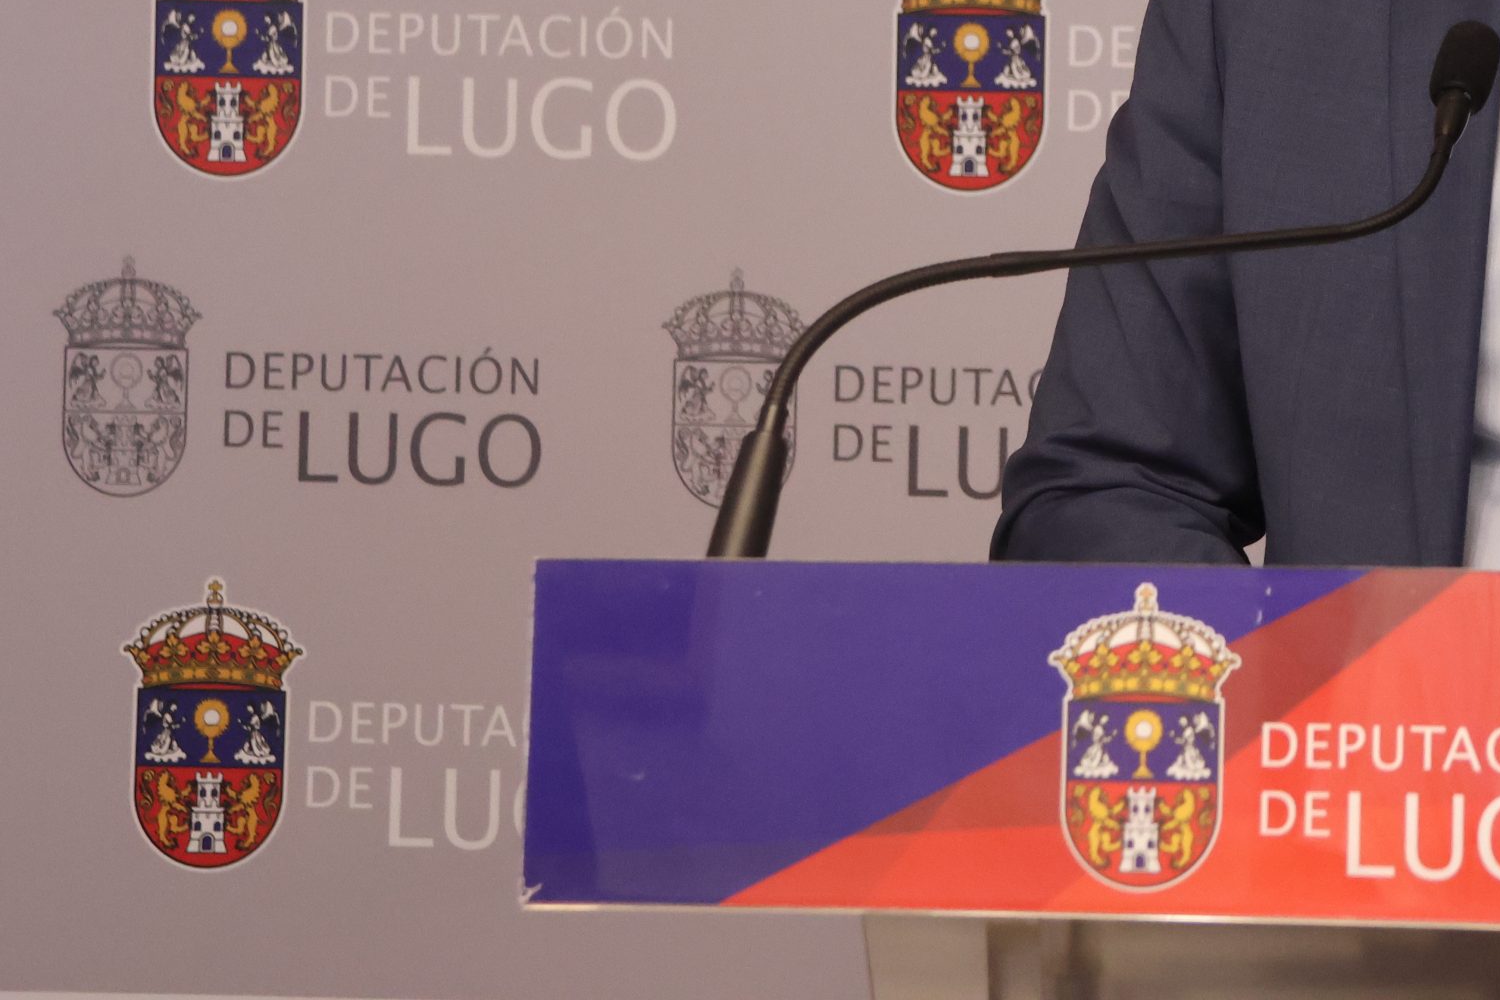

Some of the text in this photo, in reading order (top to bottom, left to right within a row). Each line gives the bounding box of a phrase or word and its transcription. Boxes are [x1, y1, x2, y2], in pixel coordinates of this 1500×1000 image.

[325, 6, 674, 60] DEPUTACIÓN
[324, 75, 677, 161] DE LUGO
[224, 347, 539, 396] DEPUTACIÓN
[223, 409, 542, 489] DE LUGO
[832, 423, 893, 463] DE
[308, 700, 530, 747] DEPUTA
[306, 765, 525, 850] DE LU
[1259, 790, 1331, 838] DE
